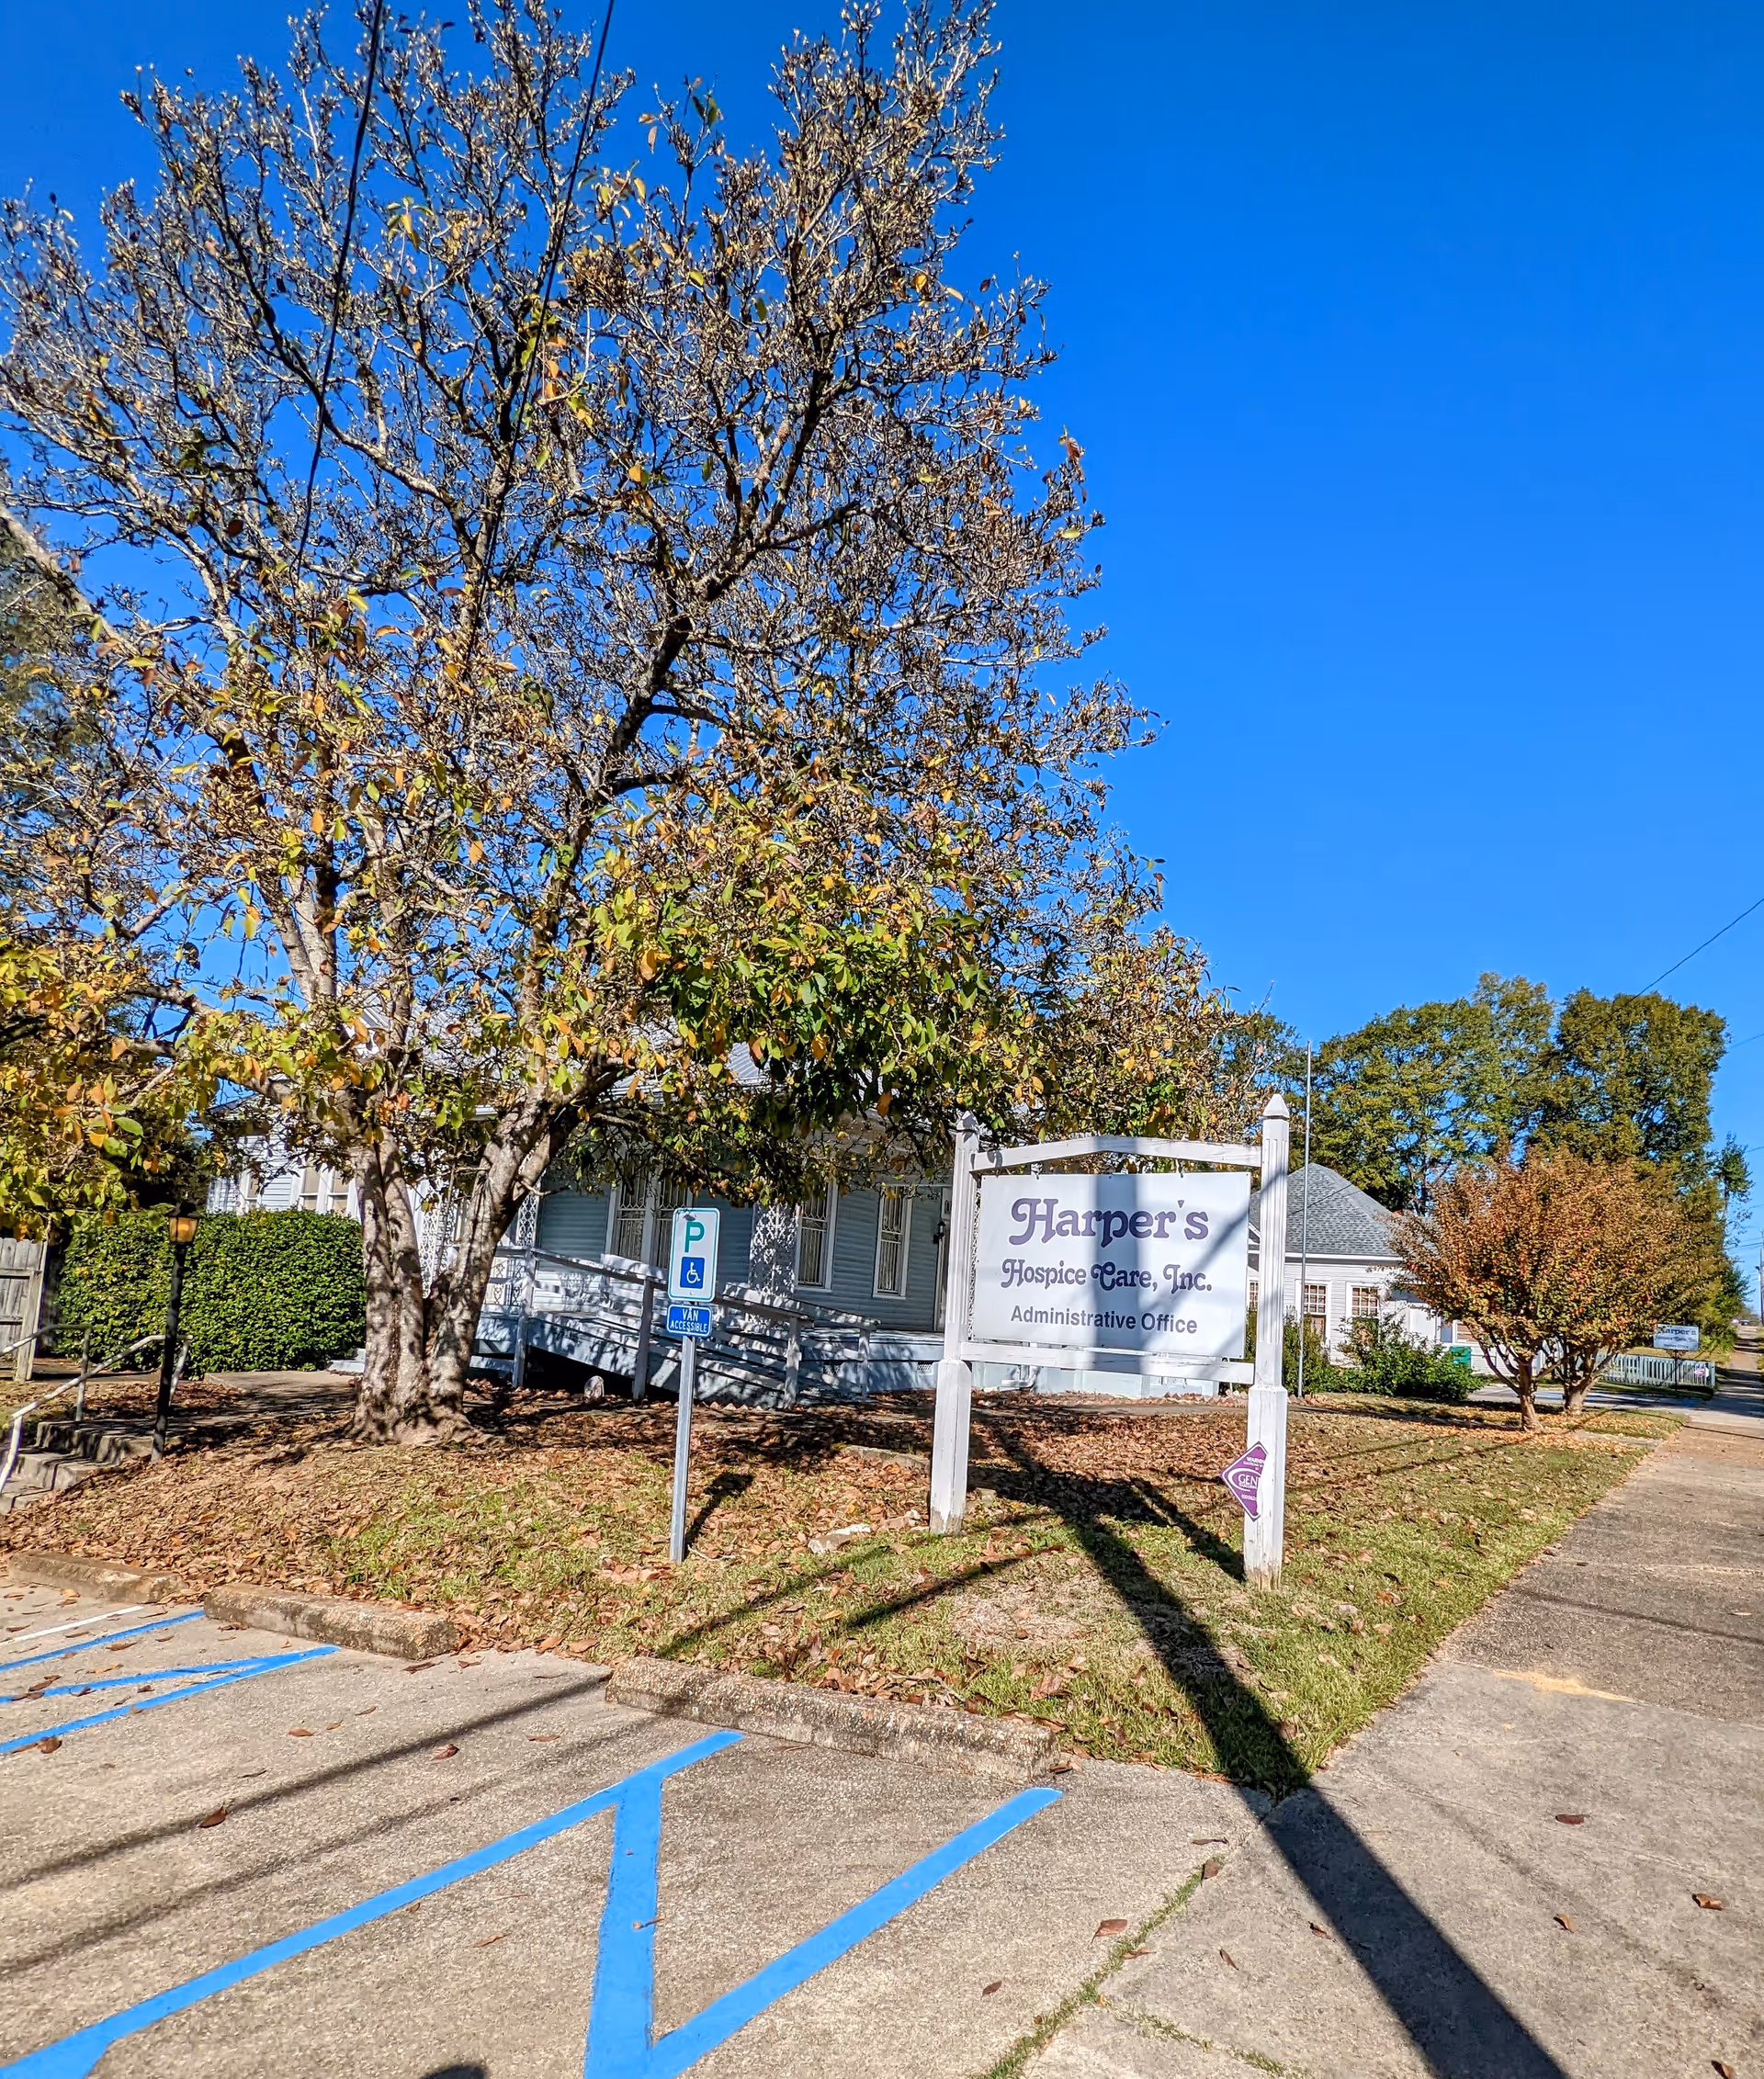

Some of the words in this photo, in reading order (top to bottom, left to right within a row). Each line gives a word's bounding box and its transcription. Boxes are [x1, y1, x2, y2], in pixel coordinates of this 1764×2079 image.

[684, 1221, 705, 1253] P
[1008, 1197, 1209, 1248] Harper's
[1001, 1259, 1087, 1290] Hospice
[1090, 1261, 1158, 1293] Care,
[1162, 1263, 1213, 1294] Inc.
[670, 1319, 707, 1333] ACCESSIBLE
[682, 1308, 698, 1321] VAN
[1010, 1305, 1136, 1330] Administrative
[1141, 1312, 1198, 1334] Office
